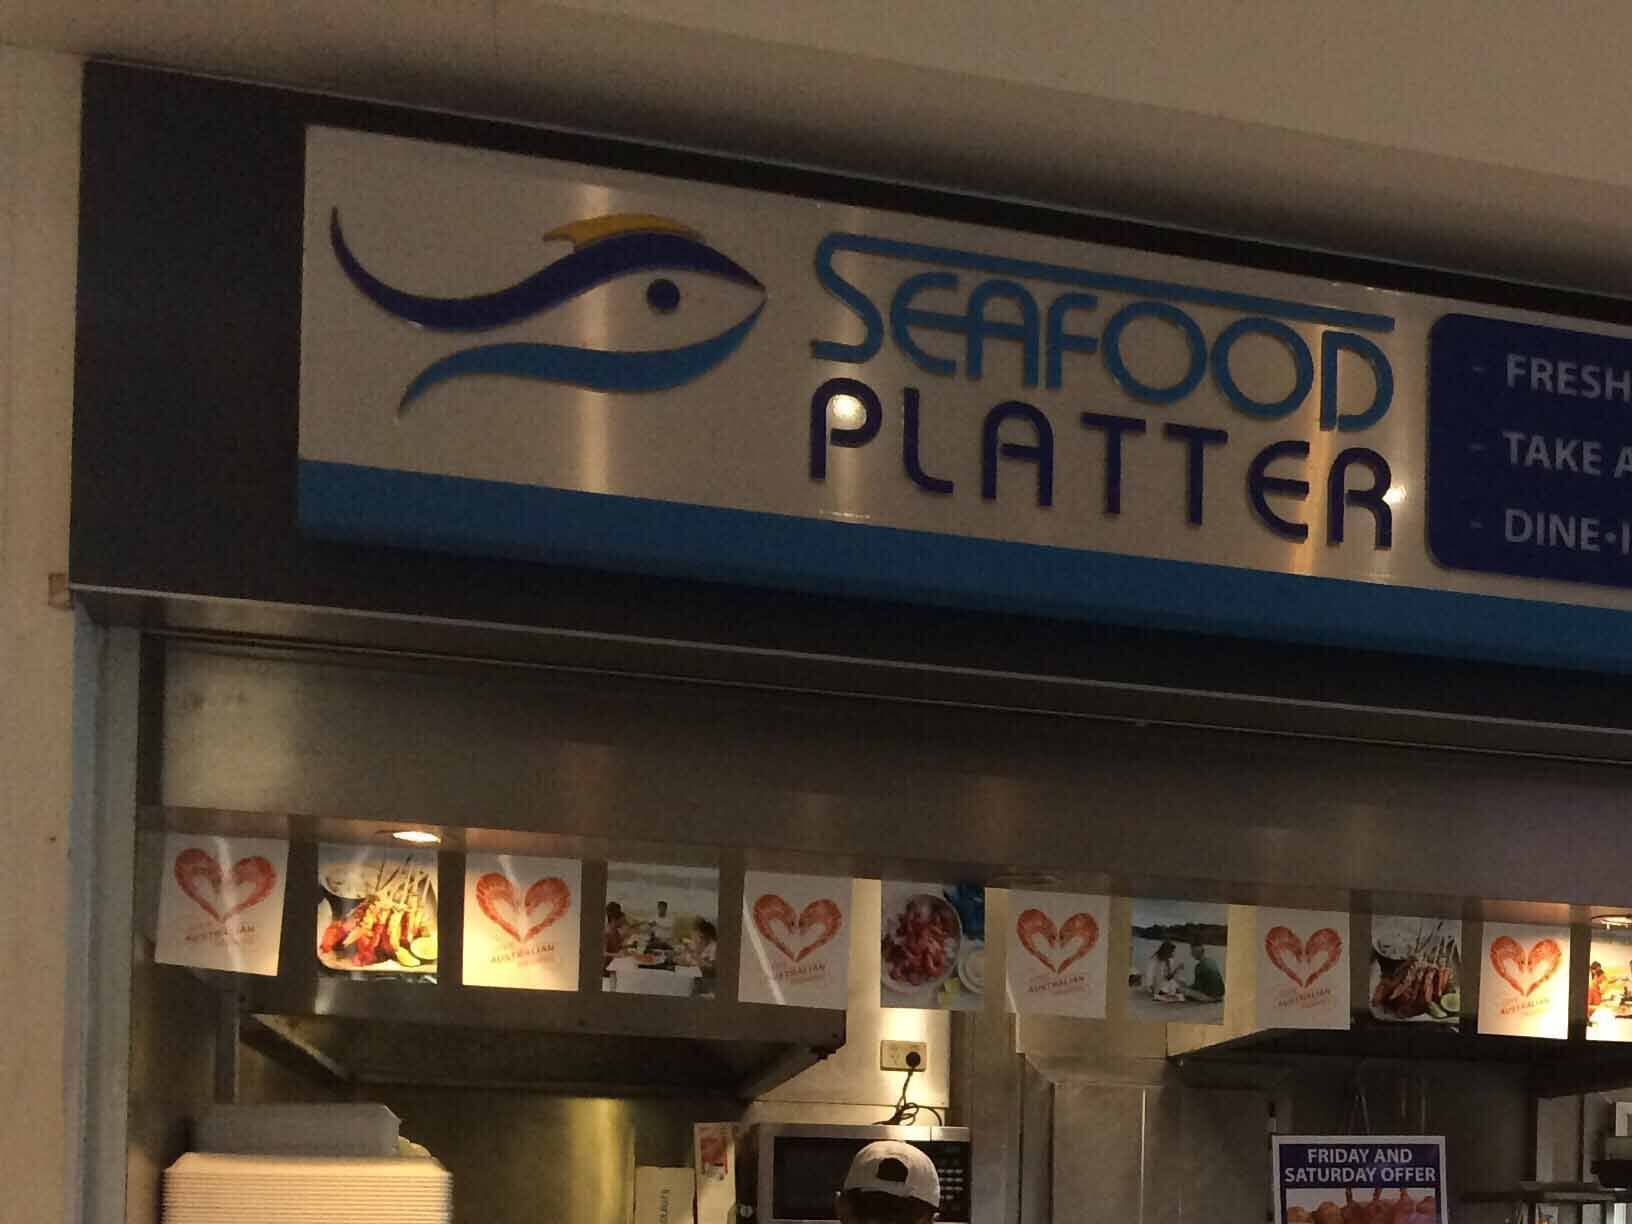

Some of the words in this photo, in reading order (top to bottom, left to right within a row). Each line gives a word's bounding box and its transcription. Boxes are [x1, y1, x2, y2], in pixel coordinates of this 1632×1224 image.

[810, 232, 1394, 432] SEAFOOD
[1506, 355, 1632, 403] FRESH
[810, 377, 1393, 550] PLATTER
[1503, 430, 1602, 477] TAKE
[1285, 1167, 1376, 1183] SATURDAY
[1381, 1167, 1436, 1182] OFFER
[1307, 1149, 1369, 1163] FRIDAY
[1374, 1148, 1413, 1163] AND
